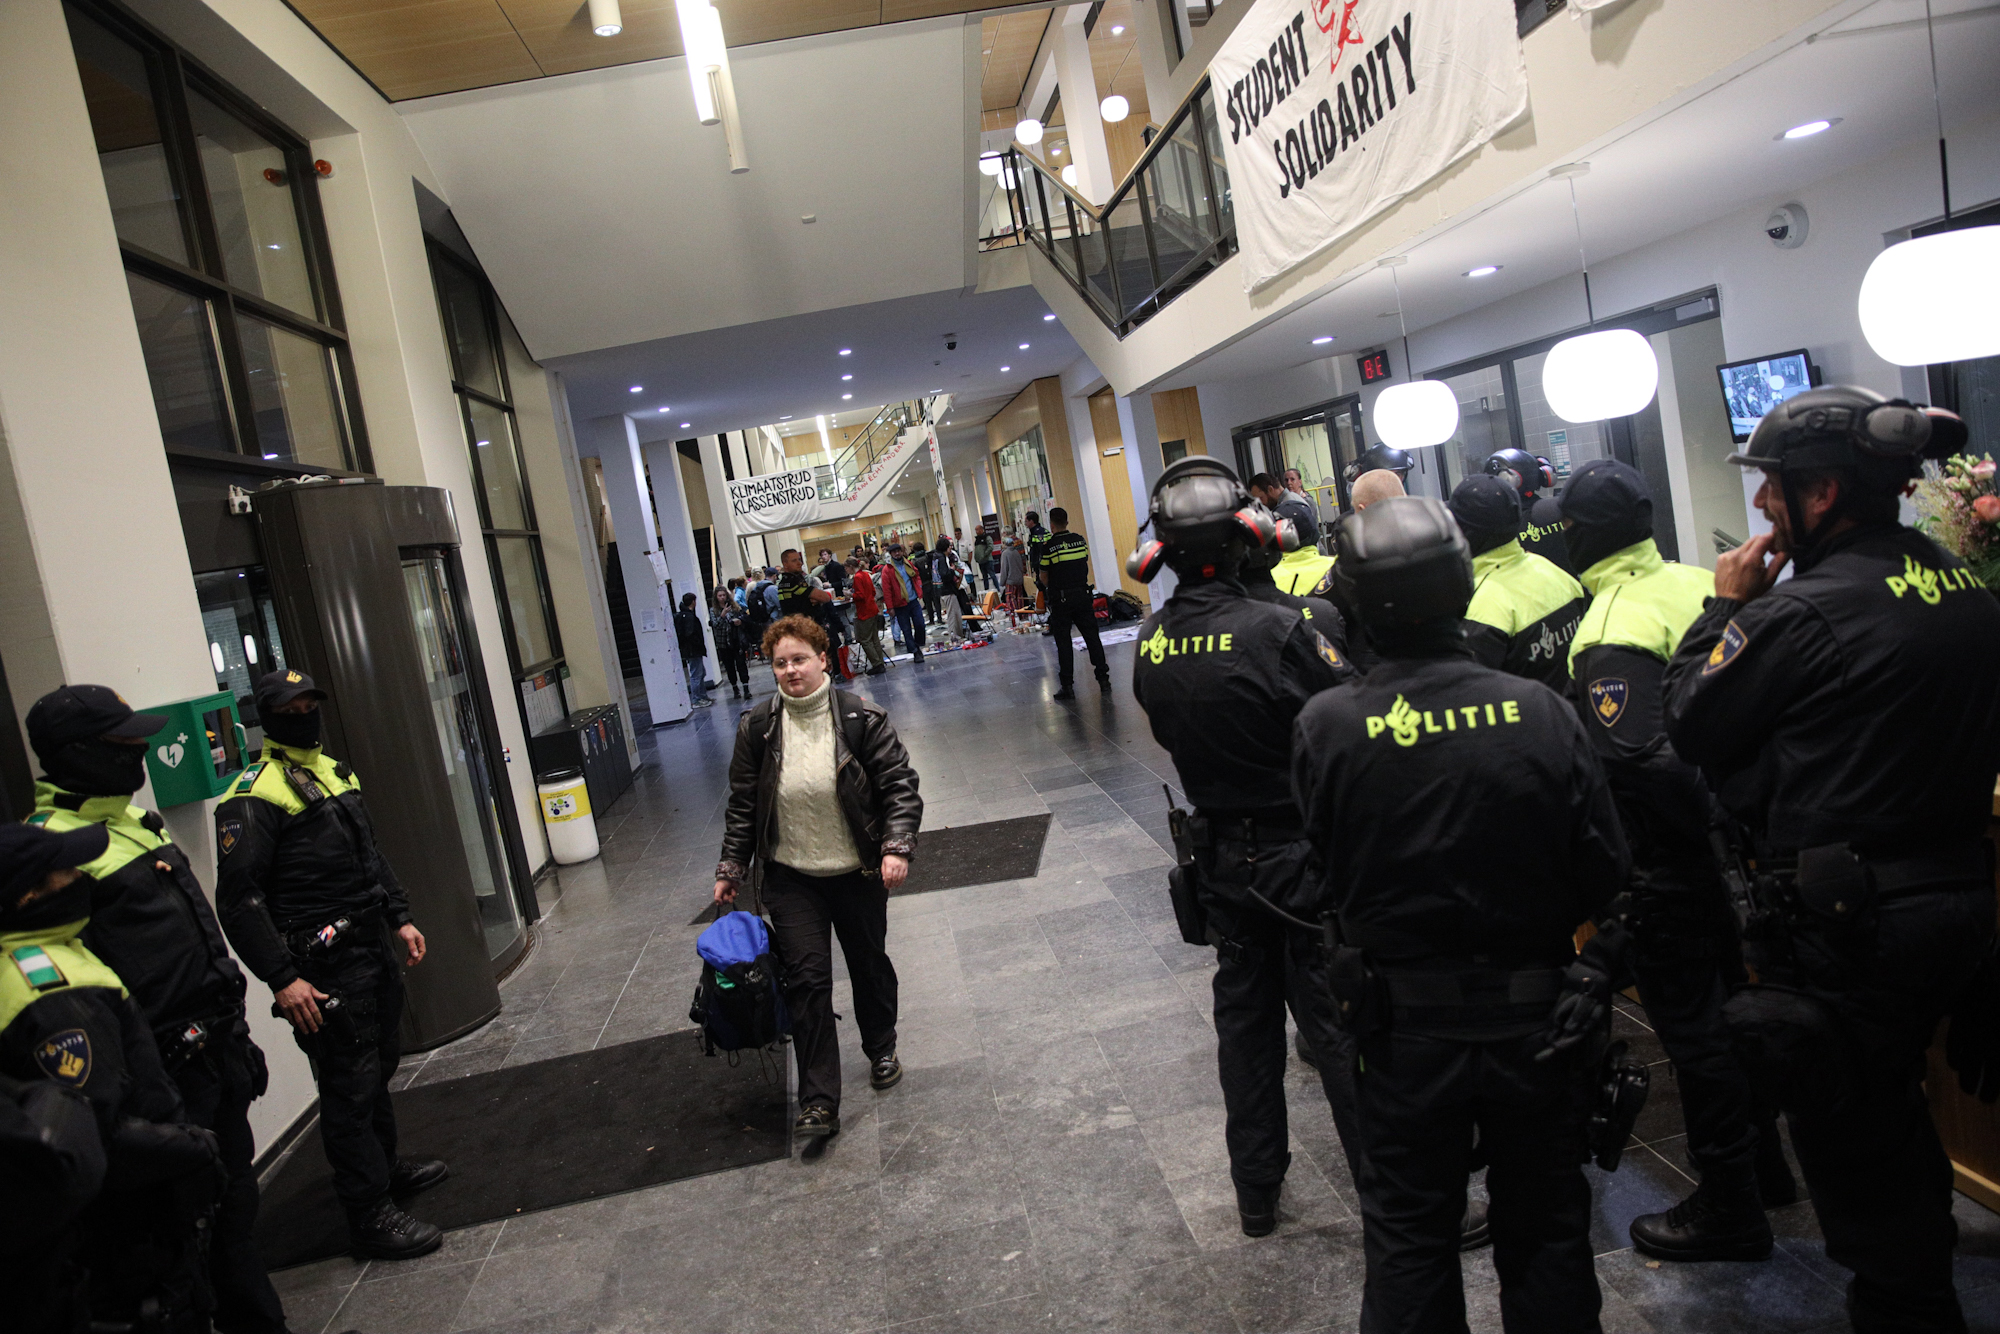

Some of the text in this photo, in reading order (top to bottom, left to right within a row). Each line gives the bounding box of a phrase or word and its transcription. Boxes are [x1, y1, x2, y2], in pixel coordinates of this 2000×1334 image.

[1226, 10, 1310, 145] STUDENT
[1273, 11, 1416, 199] SOLIDARITY
[729, 470, 812, 500] KLIMAATSTRIJD
[732, 486, 816, 516] KLASSENSTRIJD
[1519, 521, 1565, 542] POLITI
[1885, 553, 1987, 605] POLITI
[1139, 623, 1234, 665] POLITIE
[1591, 683, 1624, 695] POLITIE
[1365, 692, 1522, 747] POLITIE
